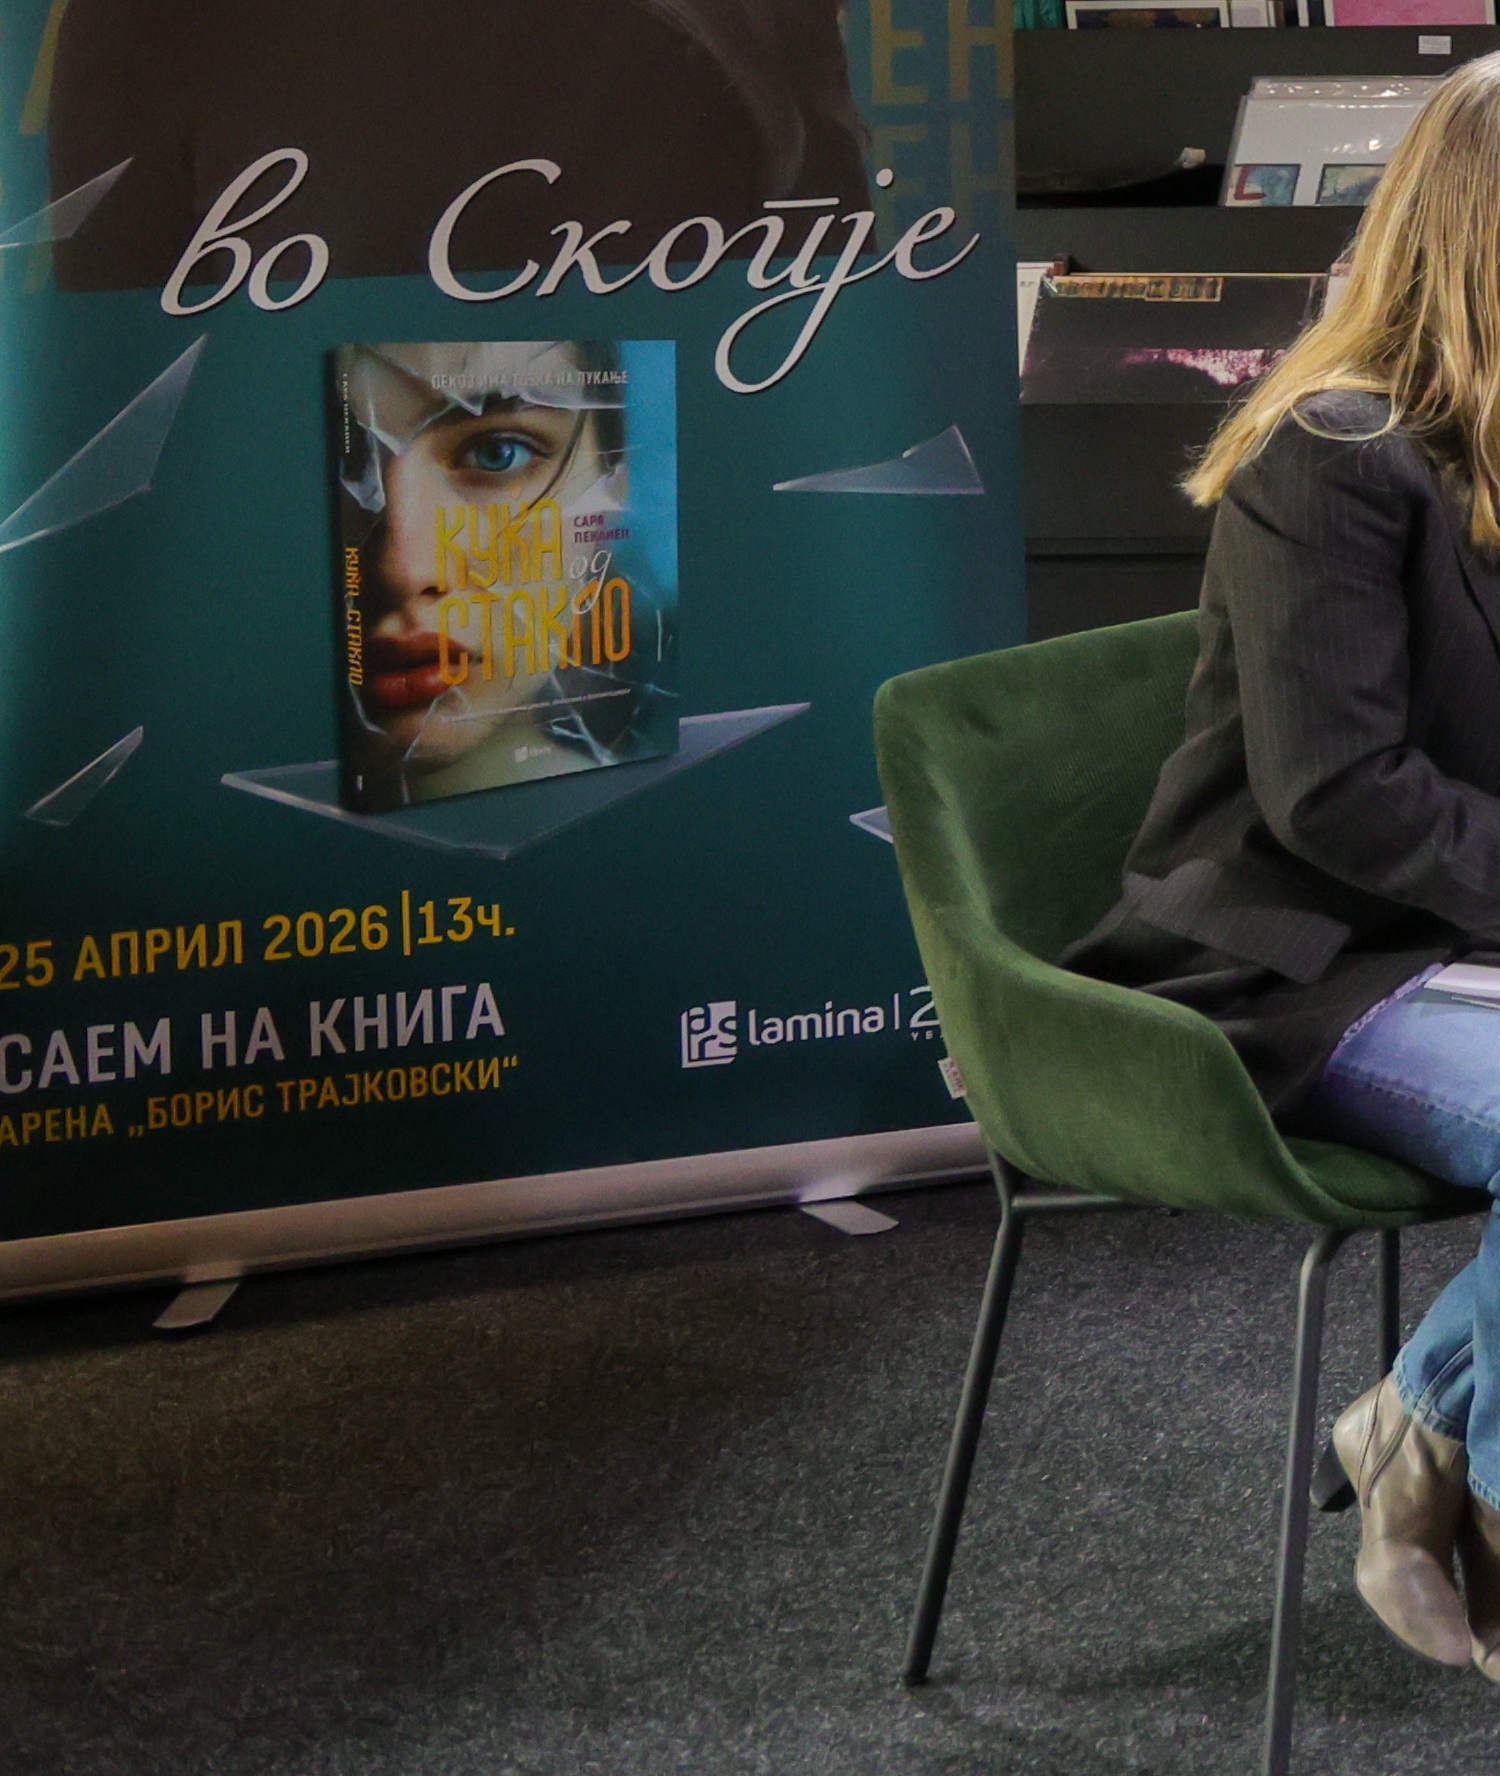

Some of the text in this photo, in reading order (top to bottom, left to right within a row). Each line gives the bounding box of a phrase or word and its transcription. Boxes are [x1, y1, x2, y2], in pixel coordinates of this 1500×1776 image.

[160, 147, 331, 316] во
[568, 547, 613, 615] од
[0, 939, 55, 990] 25
[73, 919, 243, 981] АПРИЛ
[263, 905, 389, 962] 2026
[0, 982, 506, 1095] САЕМ НА КНИГА
[748, 1001, 885, 1046] lamina
[0, 1104, 115, 1148] АРЕНА
